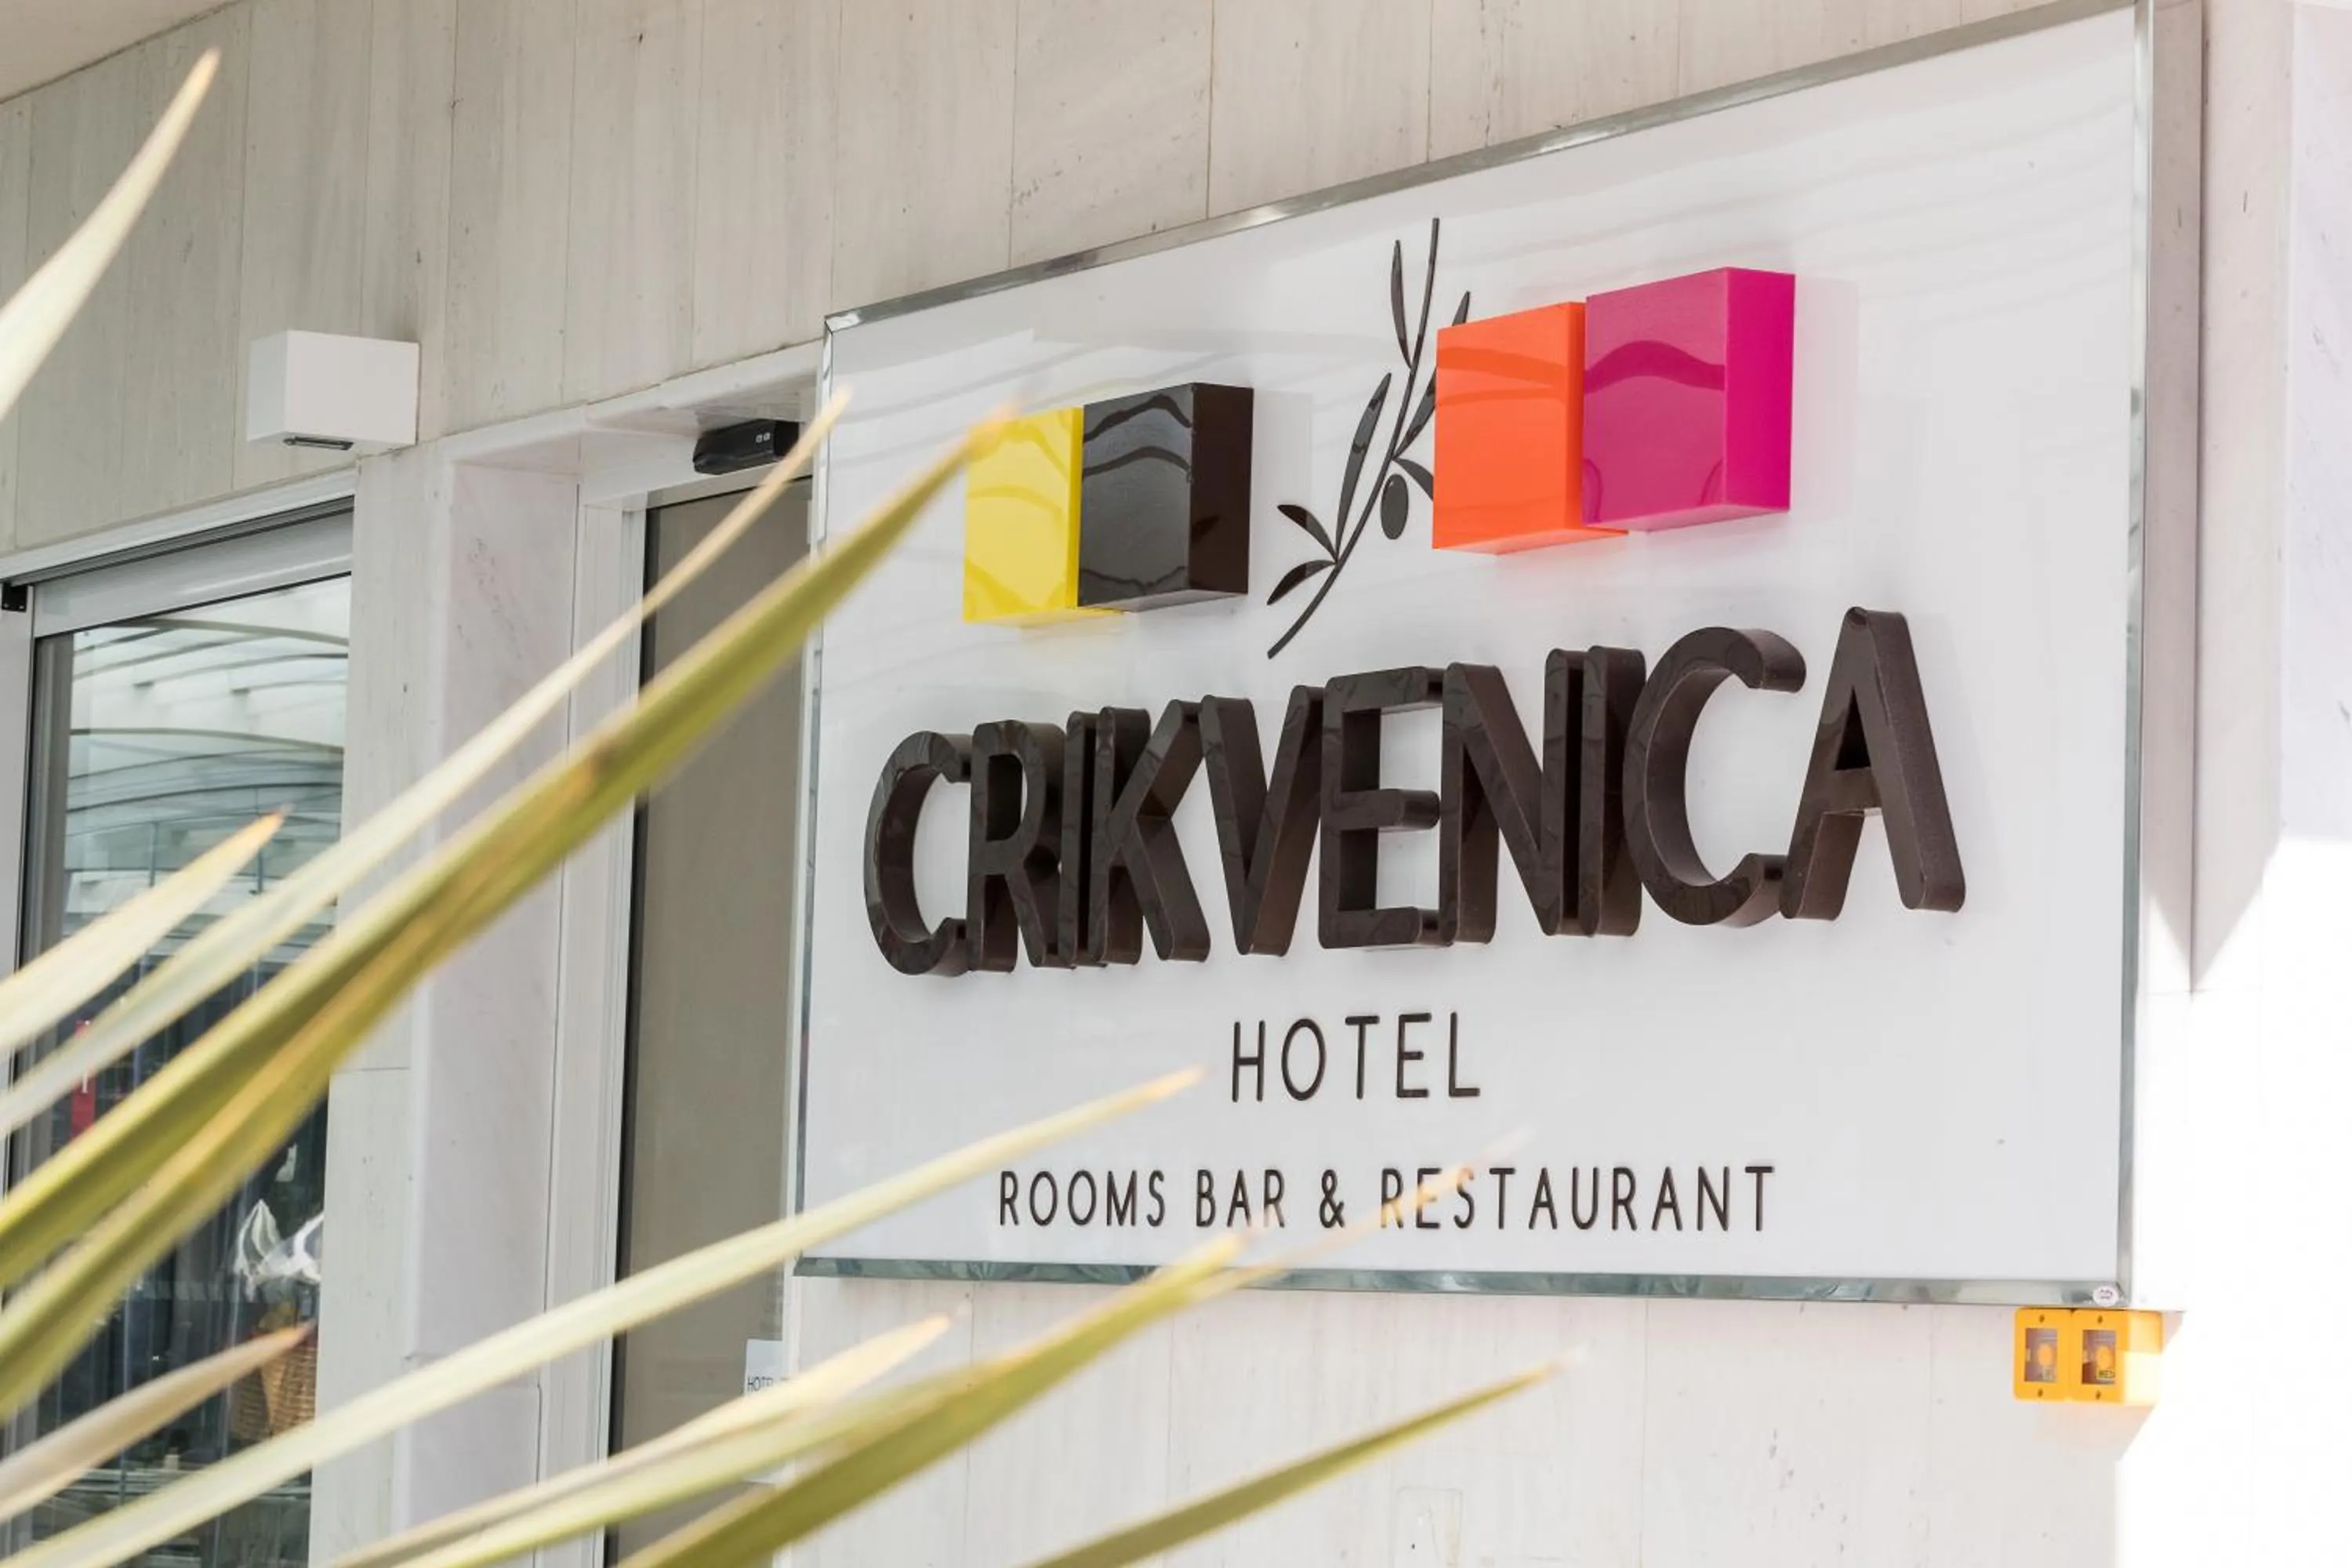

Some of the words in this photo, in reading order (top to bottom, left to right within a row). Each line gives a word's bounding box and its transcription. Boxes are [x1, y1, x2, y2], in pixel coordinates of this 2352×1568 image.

[863, 606, 1966, 978] CRIKVENICA
[1232, 1011, 1481, 1103] HOTEL
[999, 1170, 1166, 1228] ROOMS
[1196, 1168, 1286, 1229] BAR
[1319, 1168, 1345, 1229] &
[1381, 1165, 1776, 1232] RESTAURANT
